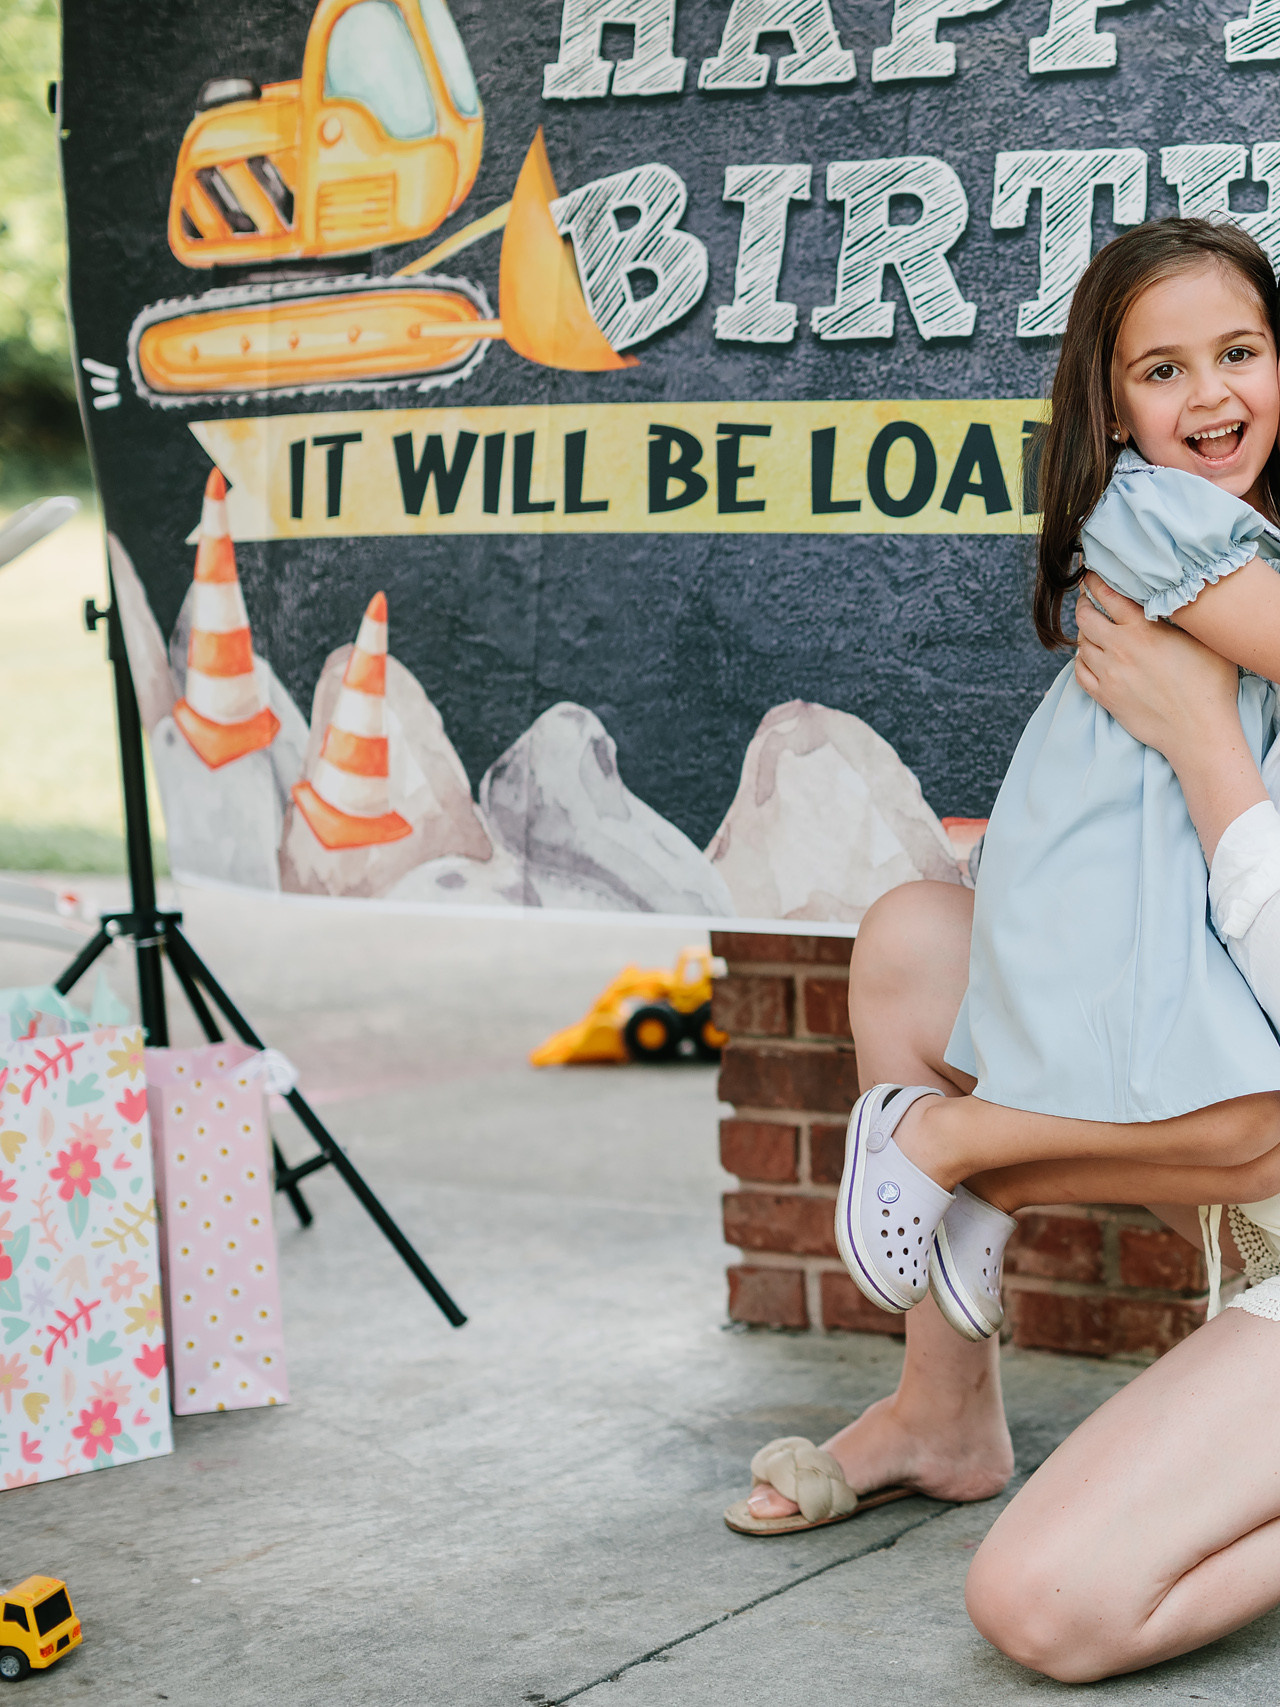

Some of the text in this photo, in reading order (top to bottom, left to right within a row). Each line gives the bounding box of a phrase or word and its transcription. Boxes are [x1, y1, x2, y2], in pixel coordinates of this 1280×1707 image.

[289, 431, 362, 519] IT
[393, 429, 609, 516] WILL
[648, 423, 771, 514] BE
